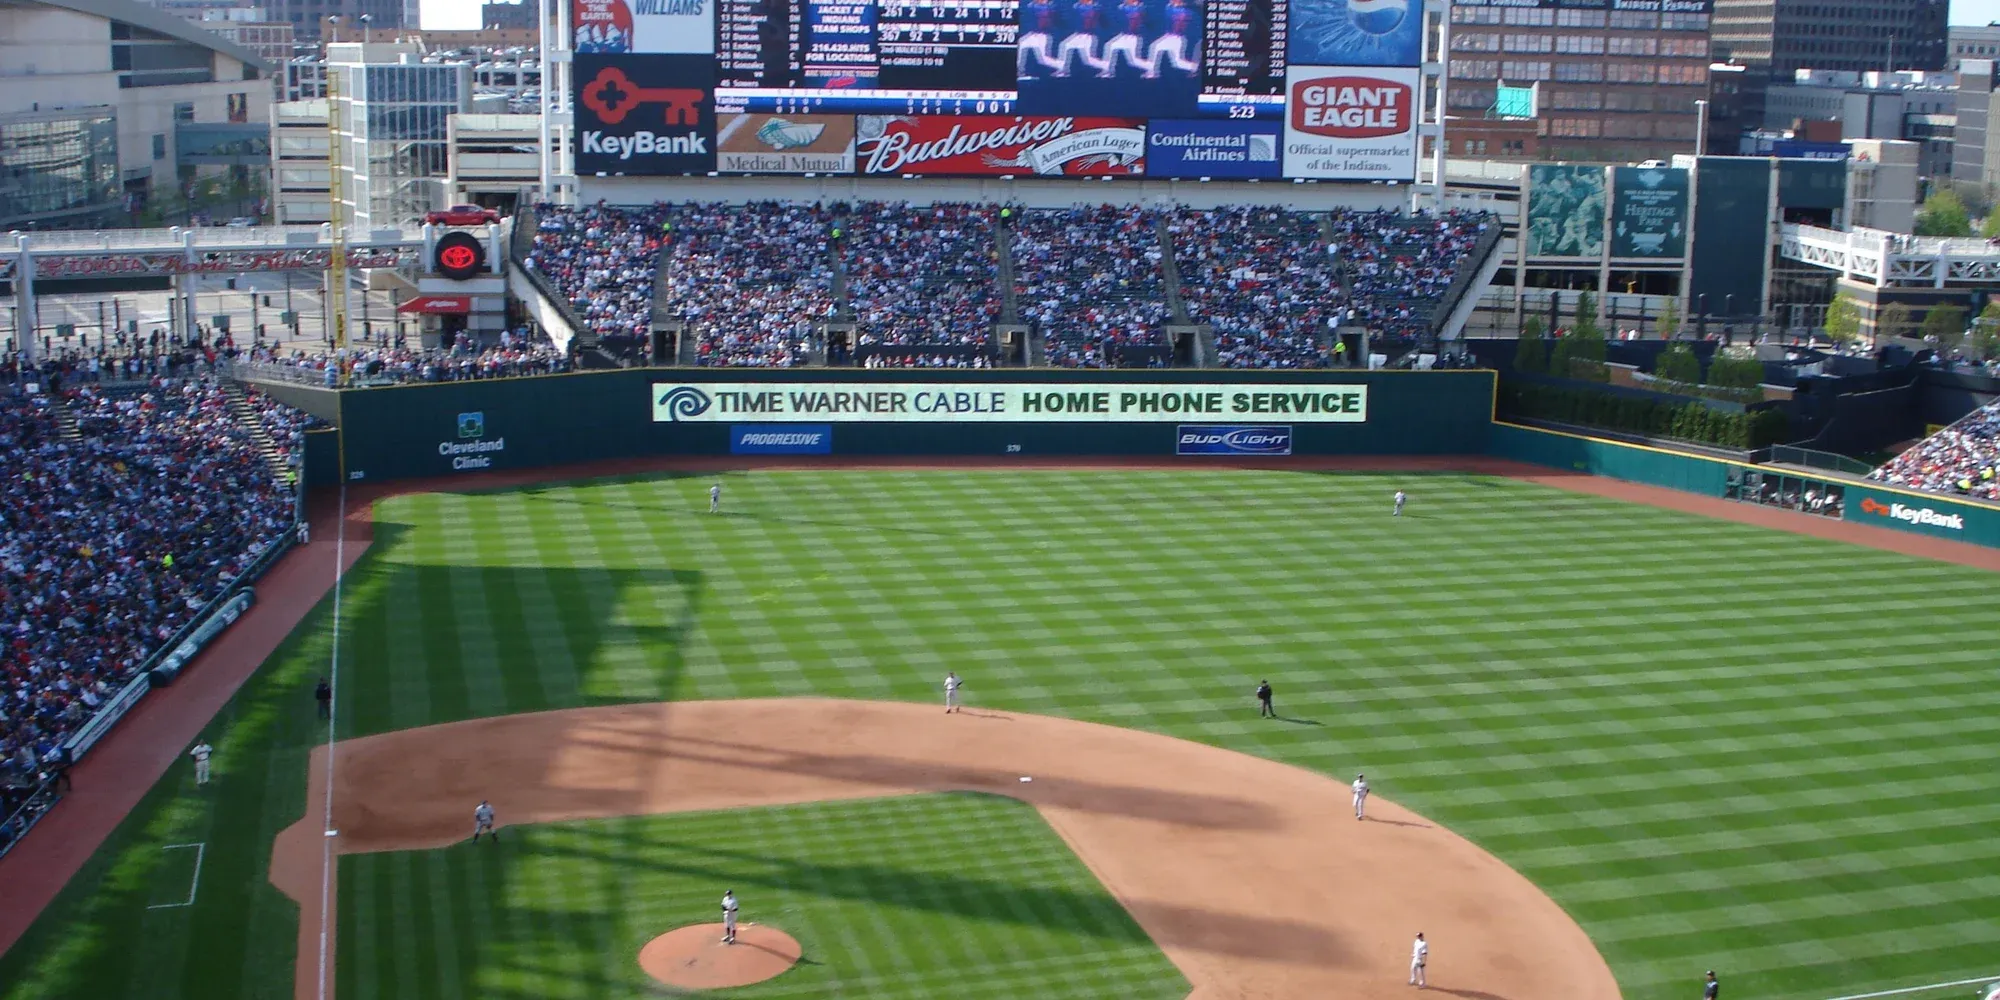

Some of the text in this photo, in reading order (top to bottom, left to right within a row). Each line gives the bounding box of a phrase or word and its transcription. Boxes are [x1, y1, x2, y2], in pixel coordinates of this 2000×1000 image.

[587, 4, 608, 12] THE
[635, 0, 704, 15] WILLIAMS
[910, 7, 917, 17] 2
[933, 8, 945, 18] 12
[955, 8, 969, 18] 24
[978, 8, 990, 18] 11
[1001, 8, 1013, 19] 12
[581, 12, 614, 21] EARTH
[812, 24, 839, 33] TEAM
[840, 25, 871, 34] SHOPS
[879, 31, 1016, 43] .367 92 2 1 7 .370
[789, 52, 796, 60] C
[805, 53, 877, 62] FOR LOCATIONS
[1302, 85, 1402, 107] GIANT
[921, 106, 929, 114] 4
[976, 101, 1010, 114] 0 0 1
[1229, 105, 1256, 119] 5:23
[1303, 107, 1398, 128] EAGLE
[582, 131, 707, 160] KeyBank
[857, 116, 1075, 174] Budweiser
[1151, 133, 1246, 147] Continental
[1040, 131, 1141, 166] American Lager
[1182, 147, 1246, 161] Airlines
[1289, 144, 1410, 161] Official supermarket
[726, 155, 847, 171] Medical Mutual
[1306, 160, 1392, 171] of the Indians.
[1624, 204, 1677, 217] HERITAGE
[1637, 216, 1665, 226] PARK
[69, 257, 143, 274] TOYOTA
[714, 391, 1006, 412] TIME WARNER CABLE
[1022, 392, 1361, 413] HOME PHONE SERVICE
[438, 437, 504, 456] Cleveland
[740, 433, 824, 446] PROGRESSIVE
[1179, 434, 1290, 445] BUD LIGHT
[1006, 444, 1021, 453] 370
[452, 456, 492, 470] Clinic
[1890, 503, 1964, 530] KeyBank
